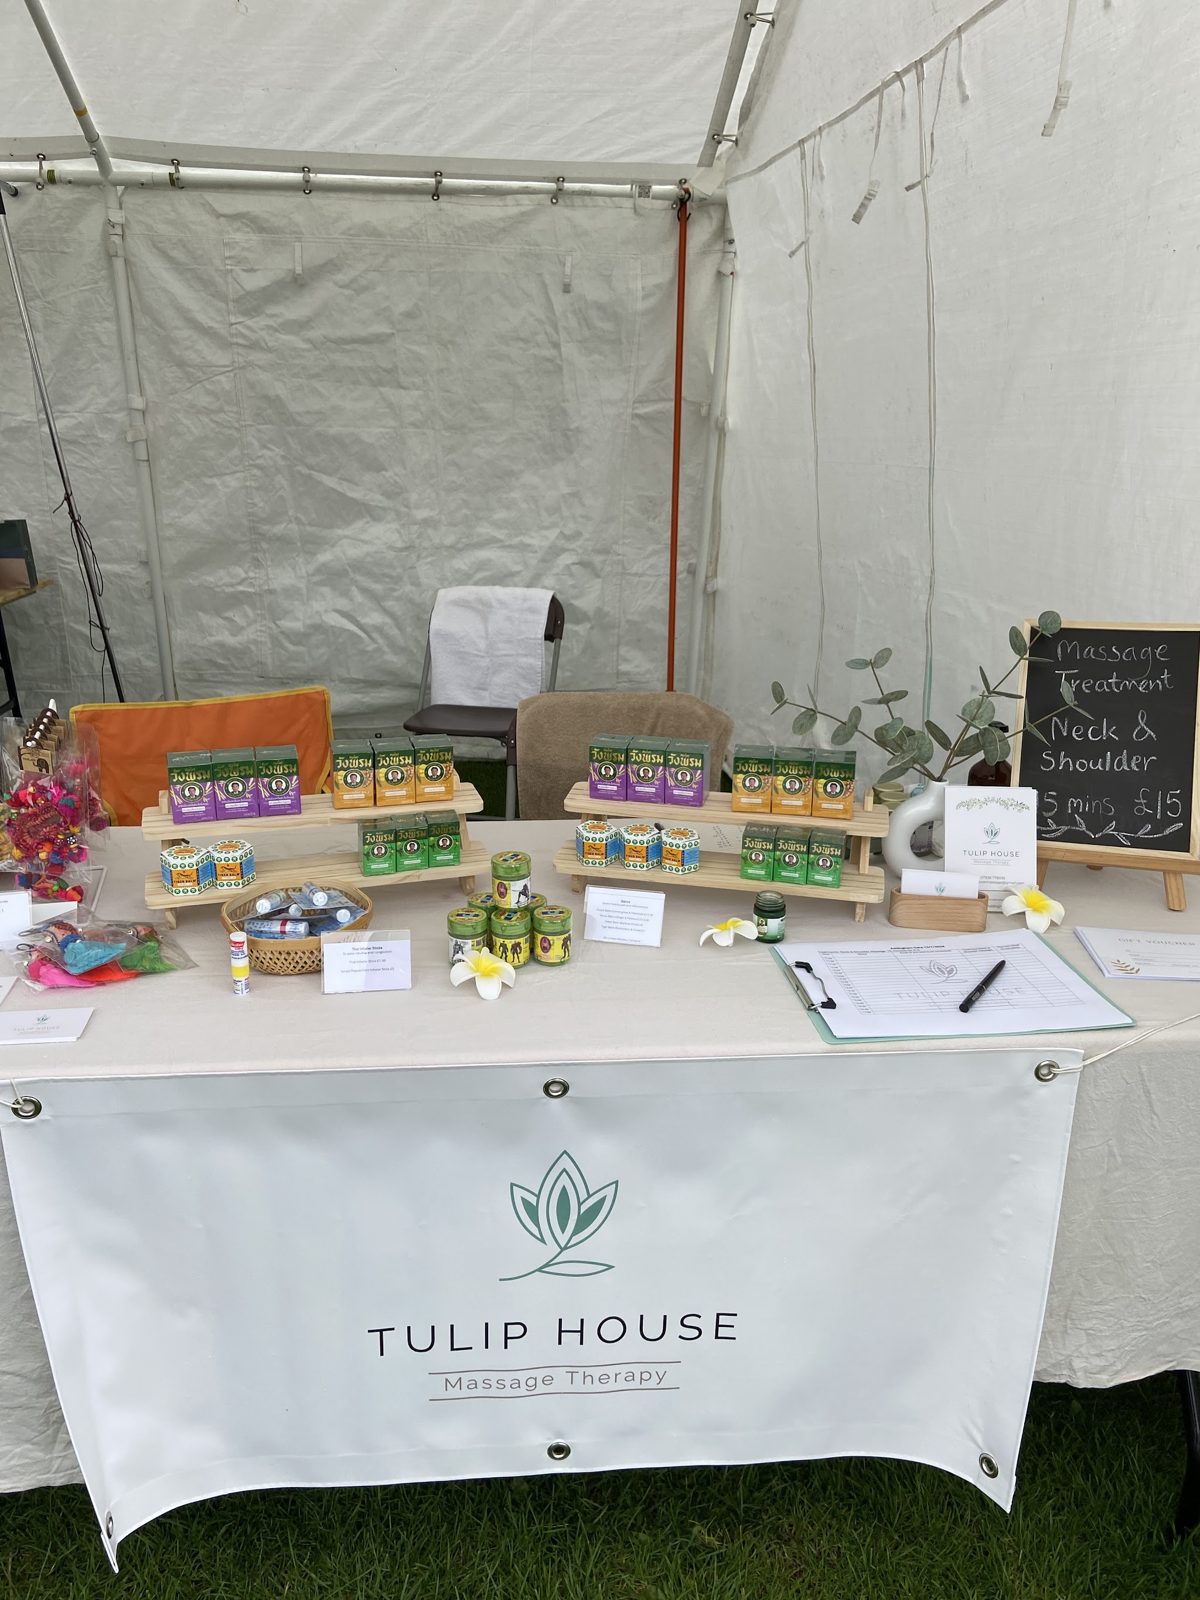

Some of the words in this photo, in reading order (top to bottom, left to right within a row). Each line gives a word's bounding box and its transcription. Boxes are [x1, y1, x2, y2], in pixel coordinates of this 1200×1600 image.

[1057, 639, 1171, 680] Massage
[1055, 668, 1174, 694] Treatment
[1051, 716, 1119, 741] Neck
[1132, 709, 1157, 742] &
[1040, 749, 1157, 772] Shoulder
[1068, 796, 1115, 816] mins
[1133, 788, 1182, 819] £15
[963, 849, 988, 857] TULIP
[990, 850, 1021, 858] HOUSE
[367, 1321, 528, 1357] TULIP
[556, 1312, 738, 1346] HOUSE
[443, 1371, 555, 1392] Massage
[565, 1367, 668, 1386] Therapy
